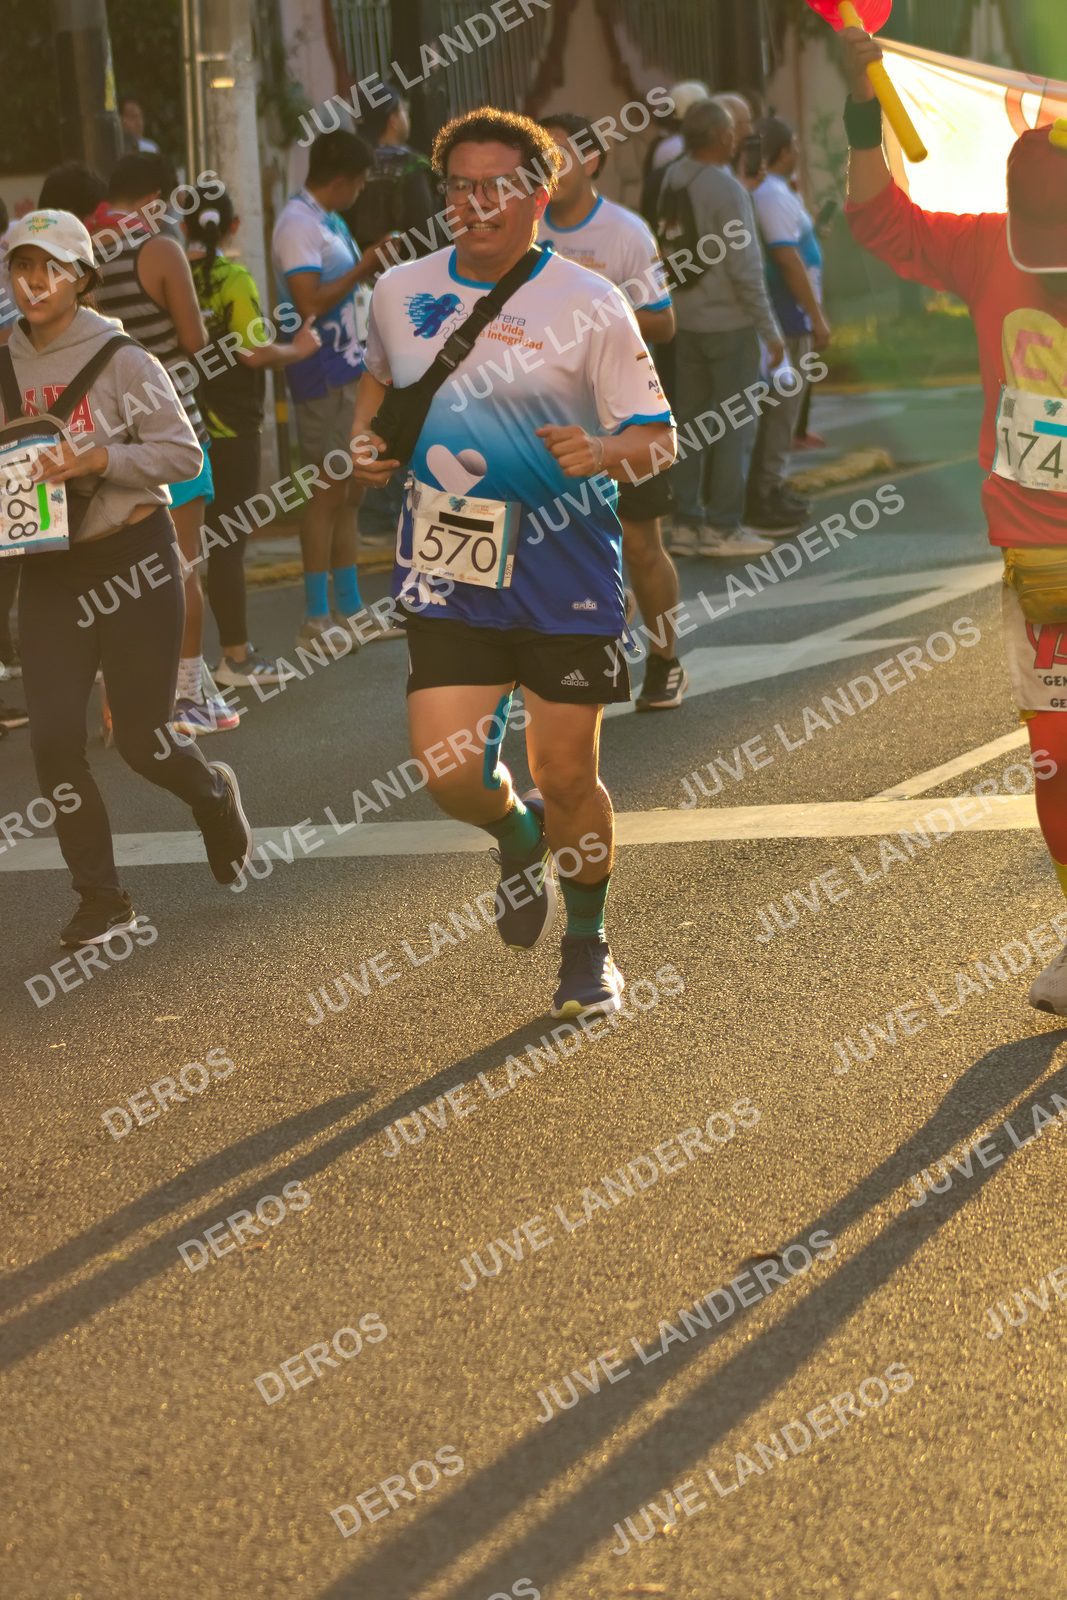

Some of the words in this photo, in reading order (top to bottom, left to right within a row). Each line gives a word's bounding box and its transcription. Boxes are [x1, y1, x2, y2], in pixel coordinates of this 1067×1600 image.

[497, 312, 526, 326] rera
[501, 324, 524, 336] Vida
[1002, 428, 1063, 478] 174
[1, 453, 38, 540] 1368
[418, 525, 497, 573] 570
